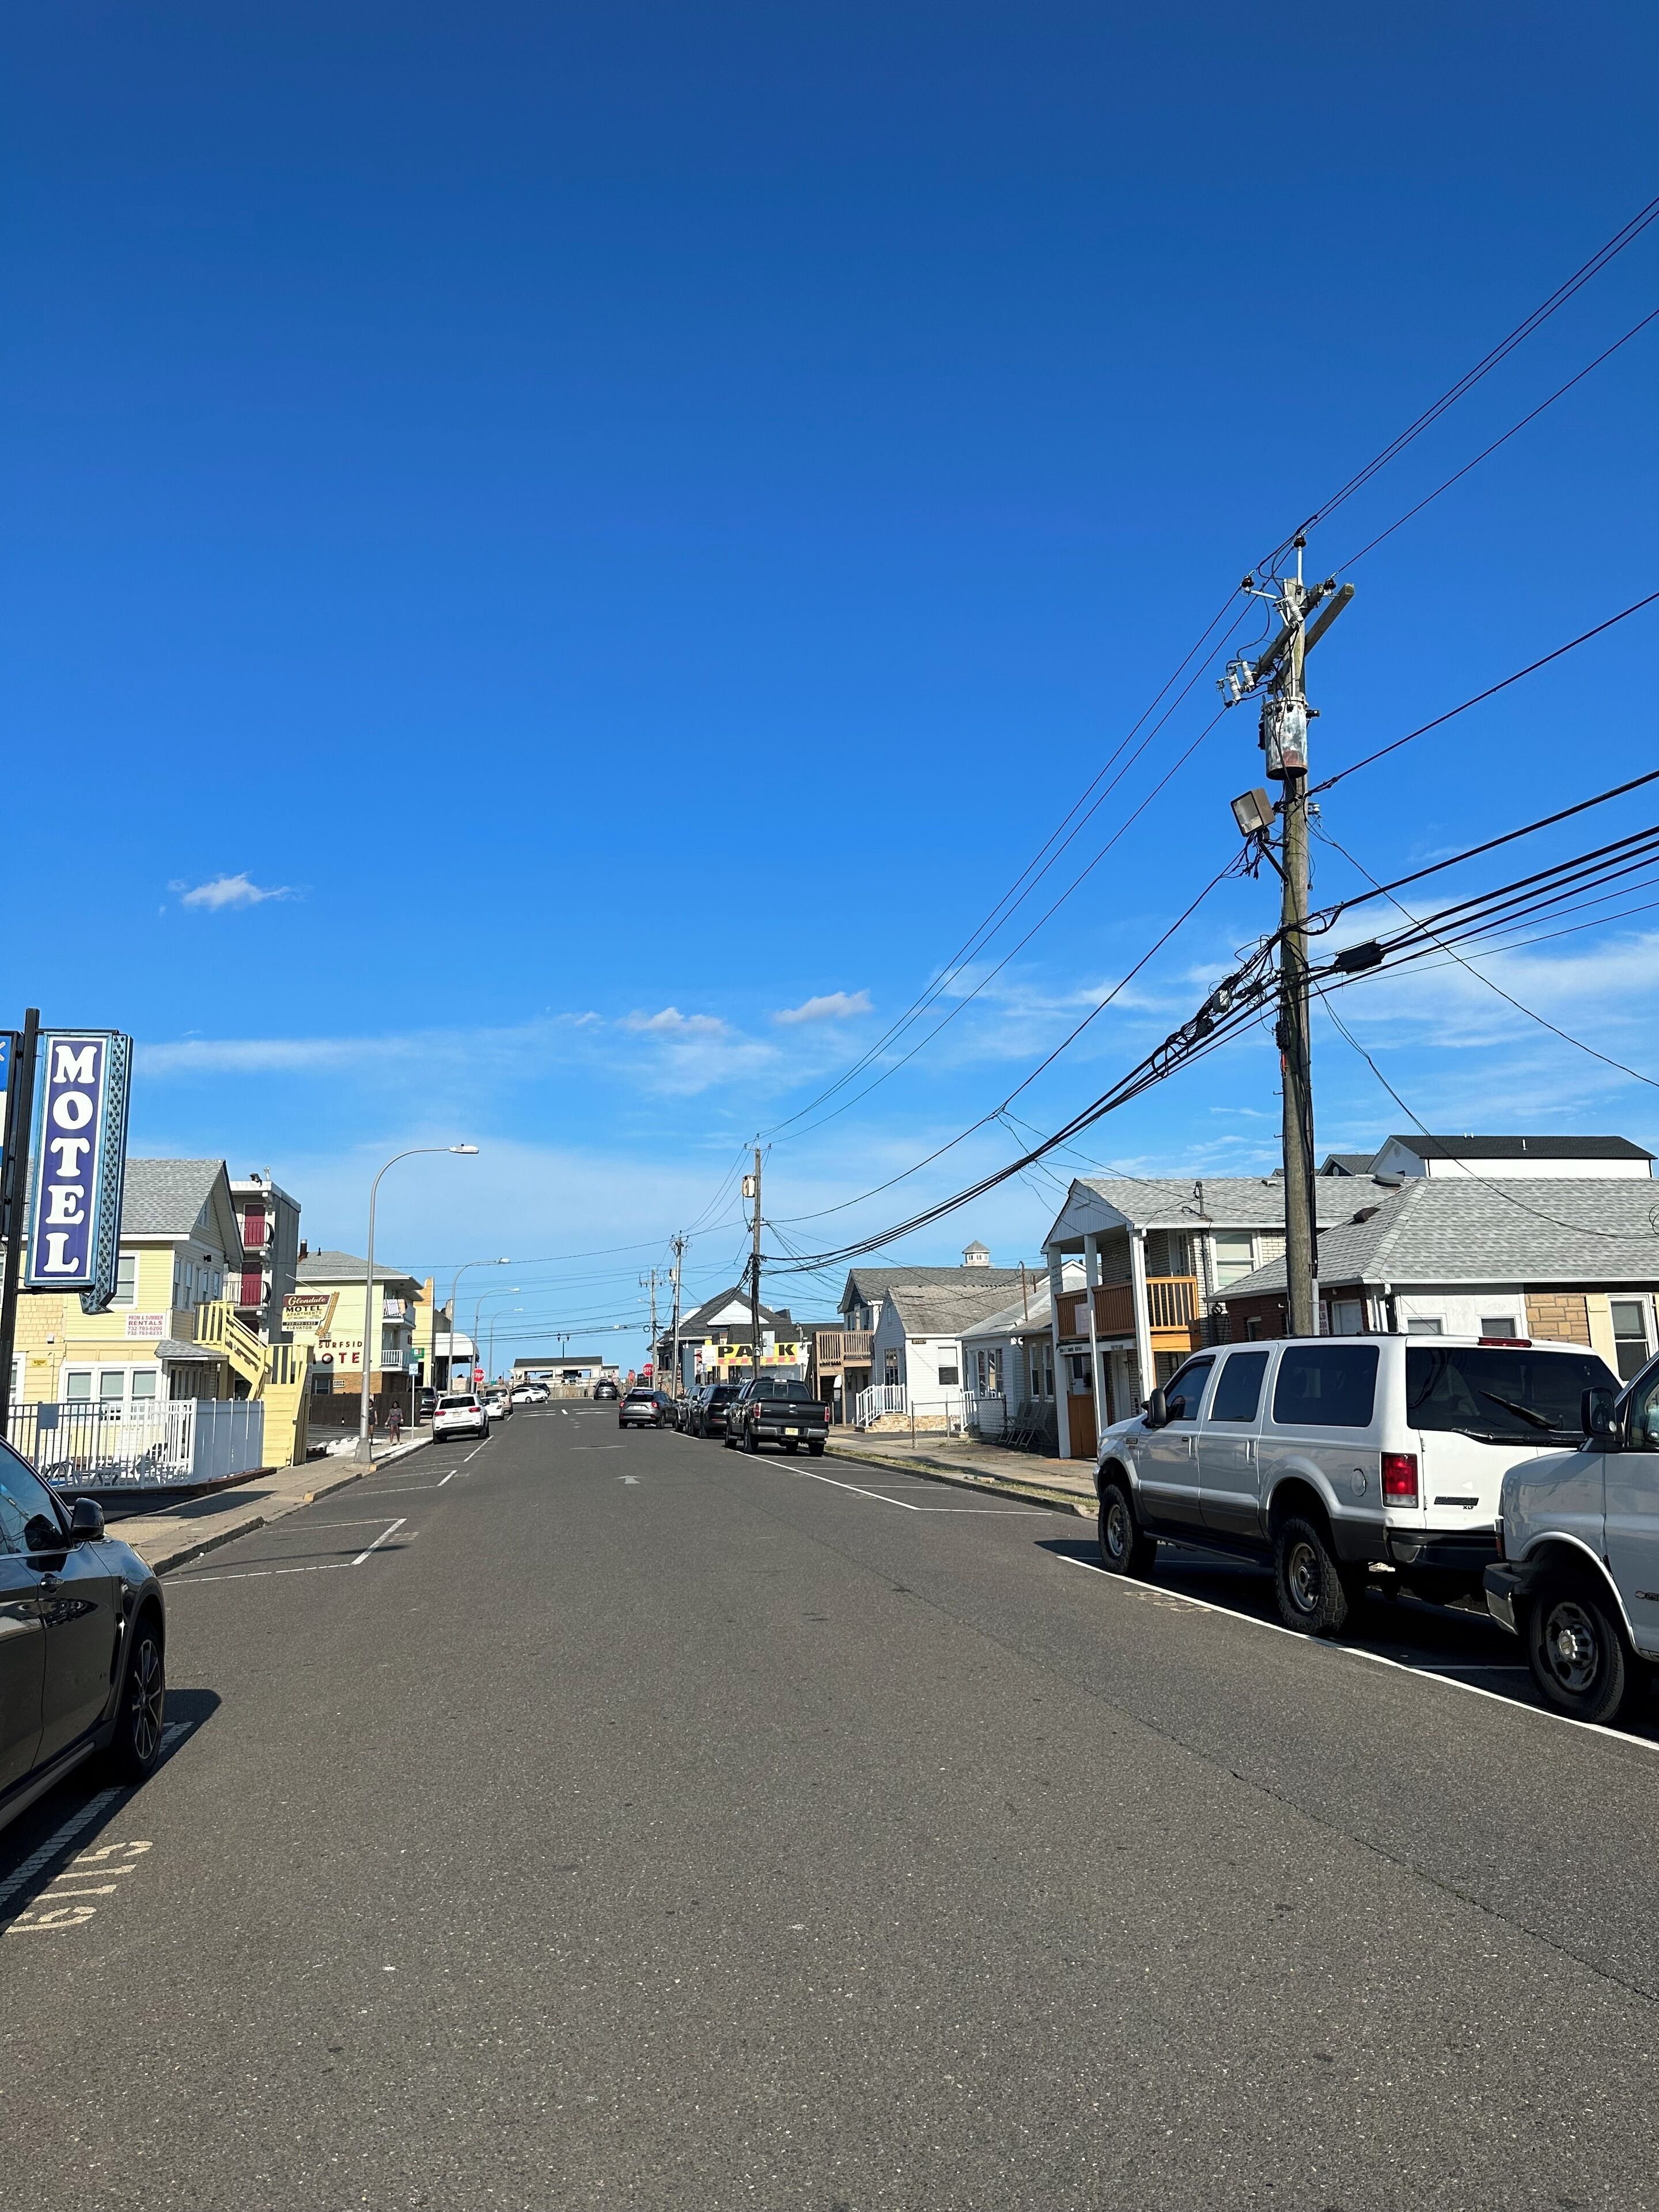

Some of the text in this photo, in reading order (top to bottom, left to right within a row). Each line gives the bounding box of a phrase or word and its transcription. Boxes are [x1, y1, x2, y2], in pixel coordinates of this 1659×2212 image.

[44, 1046, 97, 1272] MOTEL
[288, 1296, 326, 1306] Glendale
[718, 1344, 795, 1357] PAK
[313, 1352, 360, 1365] OTE
